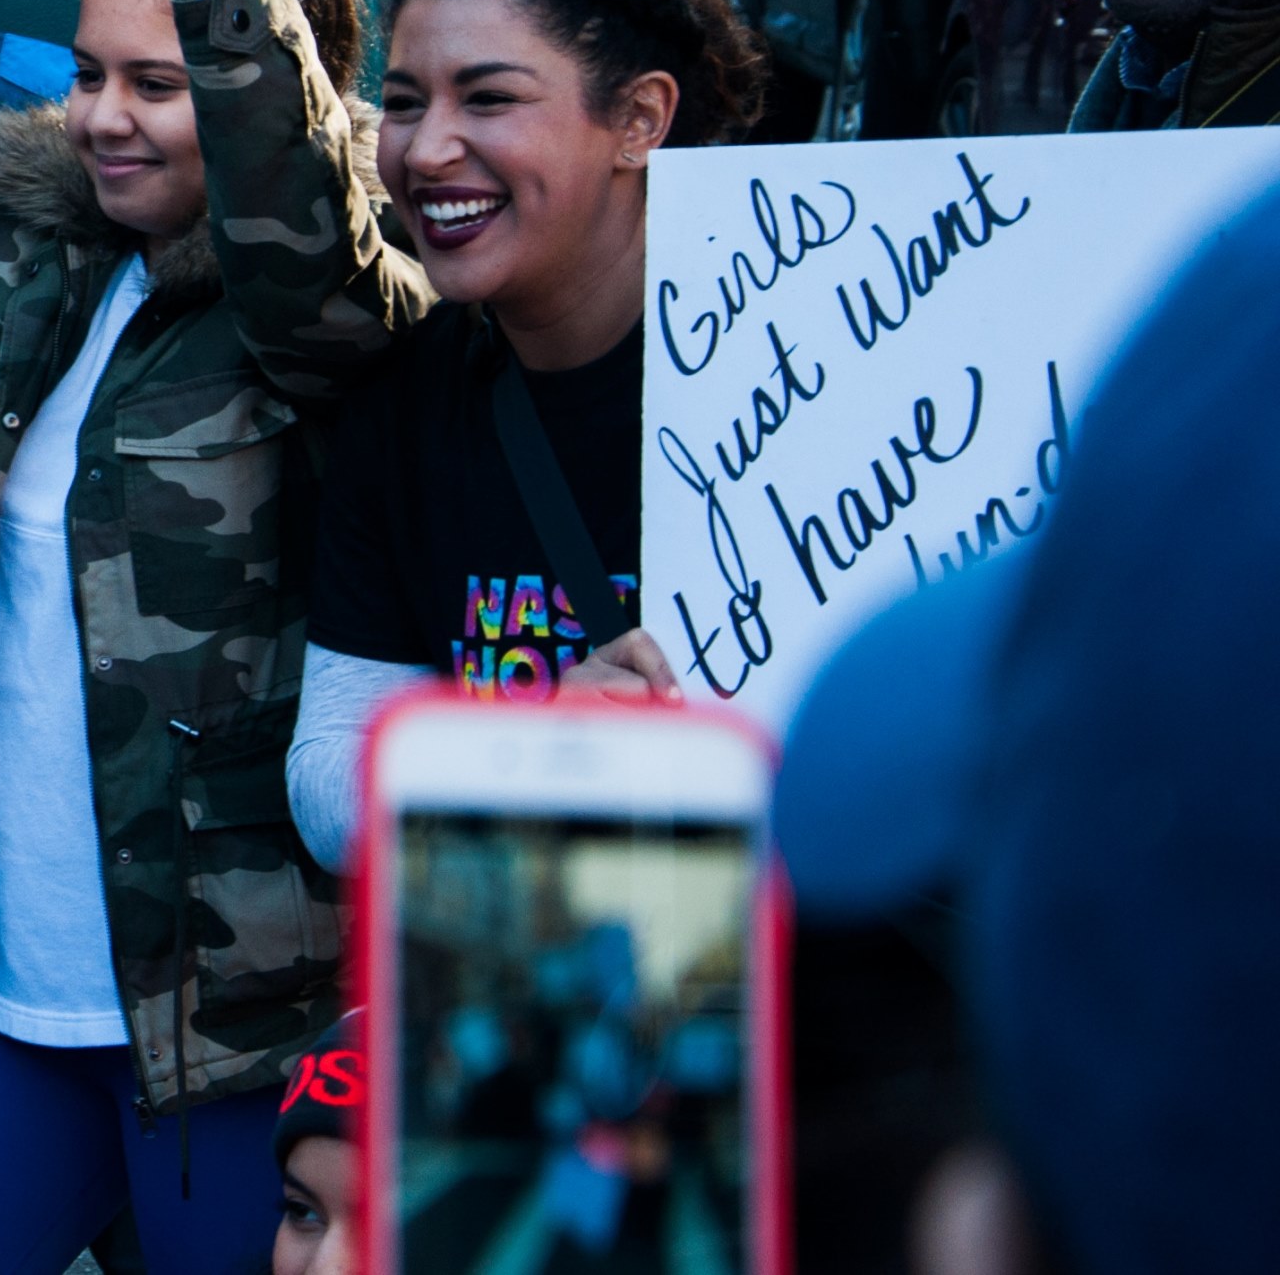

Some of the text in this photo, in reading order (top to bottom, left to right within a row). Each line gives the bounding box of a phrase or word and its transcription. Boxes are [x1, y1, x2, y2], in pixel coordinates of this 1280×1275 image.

[658, 177, 858, 376] Girls
[673, 366, 983, 700] to have
[451, 639, 594, 705] WO
